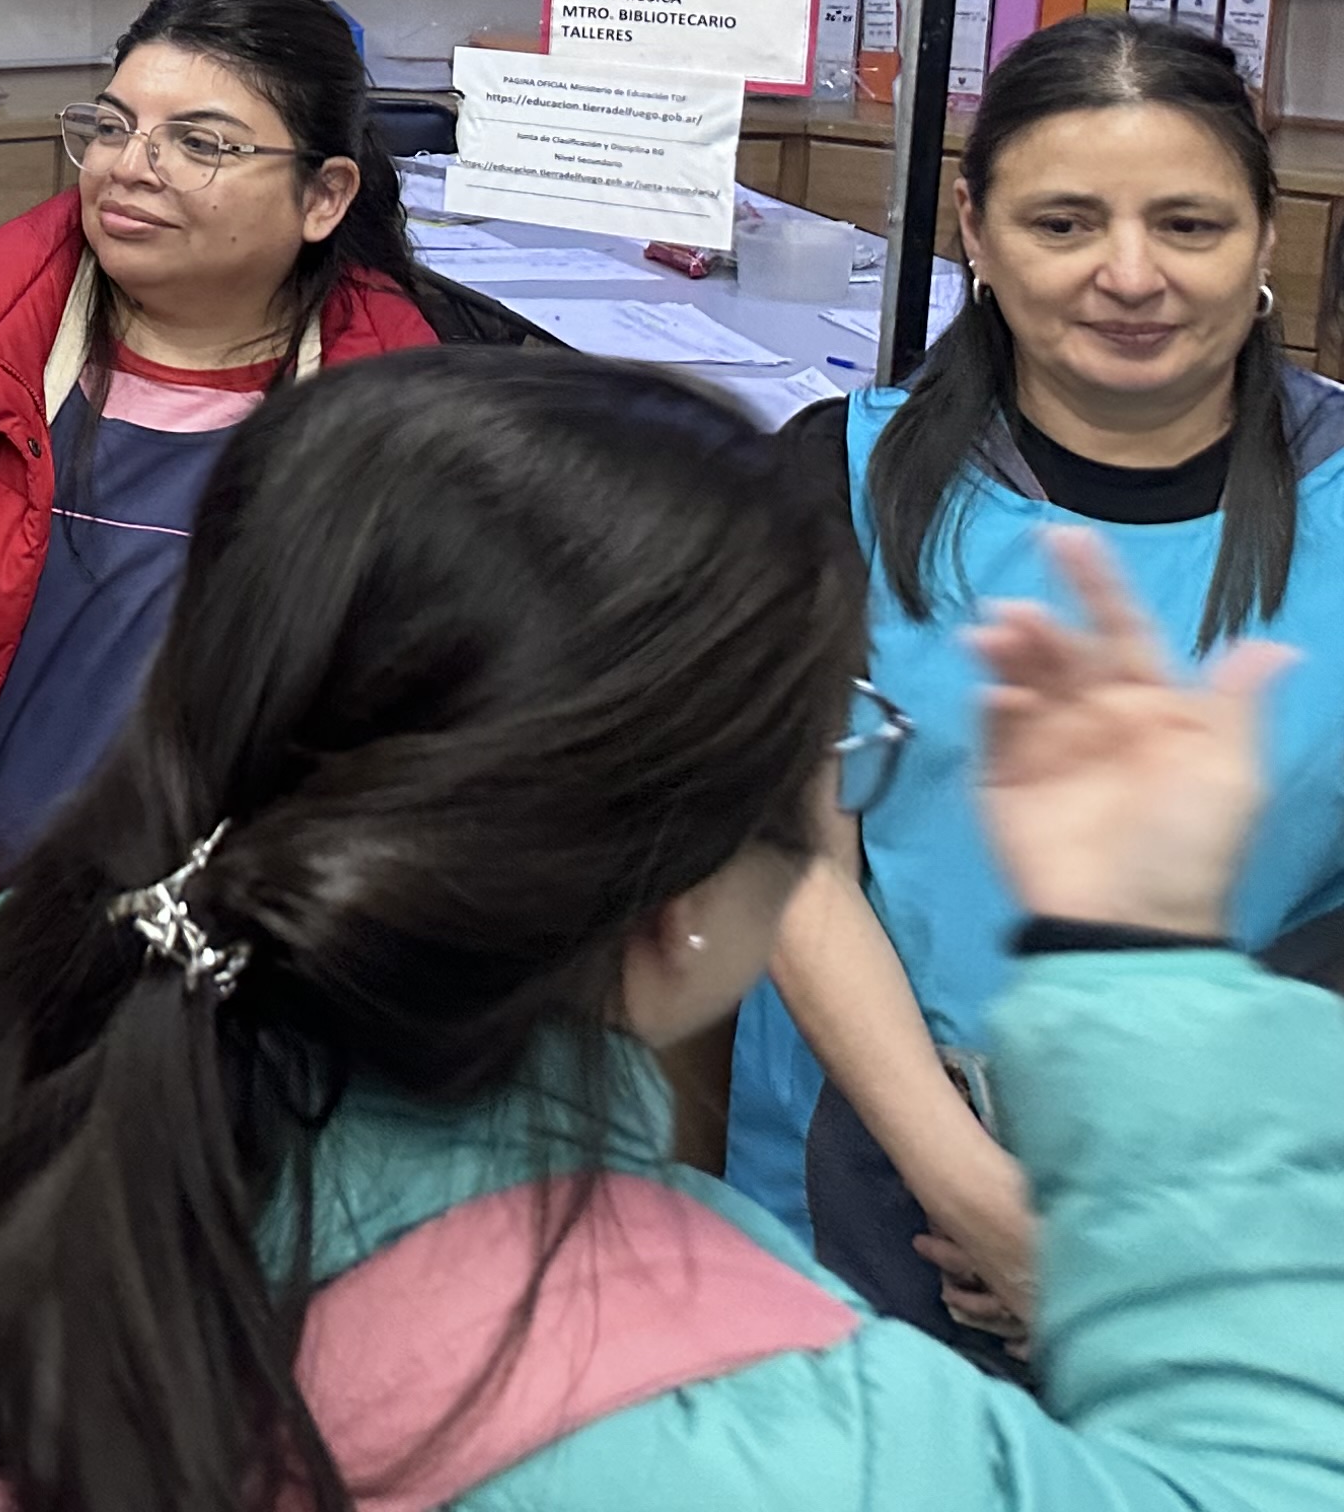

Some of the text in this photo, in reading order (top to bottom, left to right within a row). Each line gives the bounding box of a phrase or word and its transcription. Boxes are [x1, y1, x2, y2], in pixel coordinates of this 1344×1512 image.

[563, 5, 737, 29] MTRO. BIBLIOTECARIO
[561, 25, 633, 42] TALLERES
[486, 92, 703, 126] https://educacion.tierradelfuego.gob.ar/
